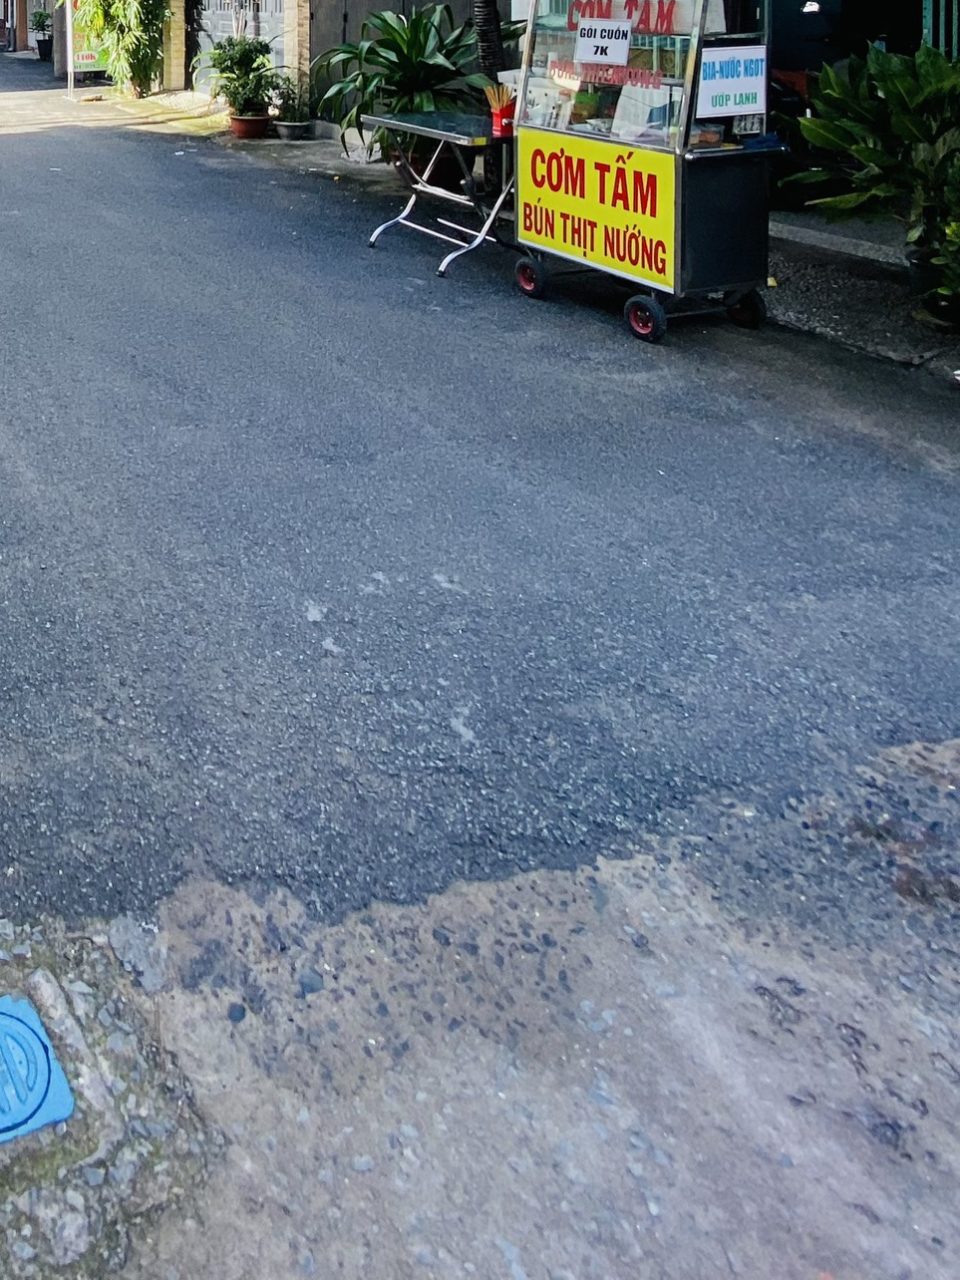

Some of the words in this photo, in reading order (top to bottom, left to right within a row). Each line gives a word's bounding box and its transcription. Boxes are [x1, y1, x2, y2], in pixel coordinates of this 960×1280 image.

[593, 45, 609, 56] 7K
[531, 147, 585, 199] CƠM
[594, 151, 657, 218] TẤM
[523, 198, 554, 240] BÚN
[560, 212, 597, 257] THỊT
[604, 224, 667, 276] NƯỚNG
